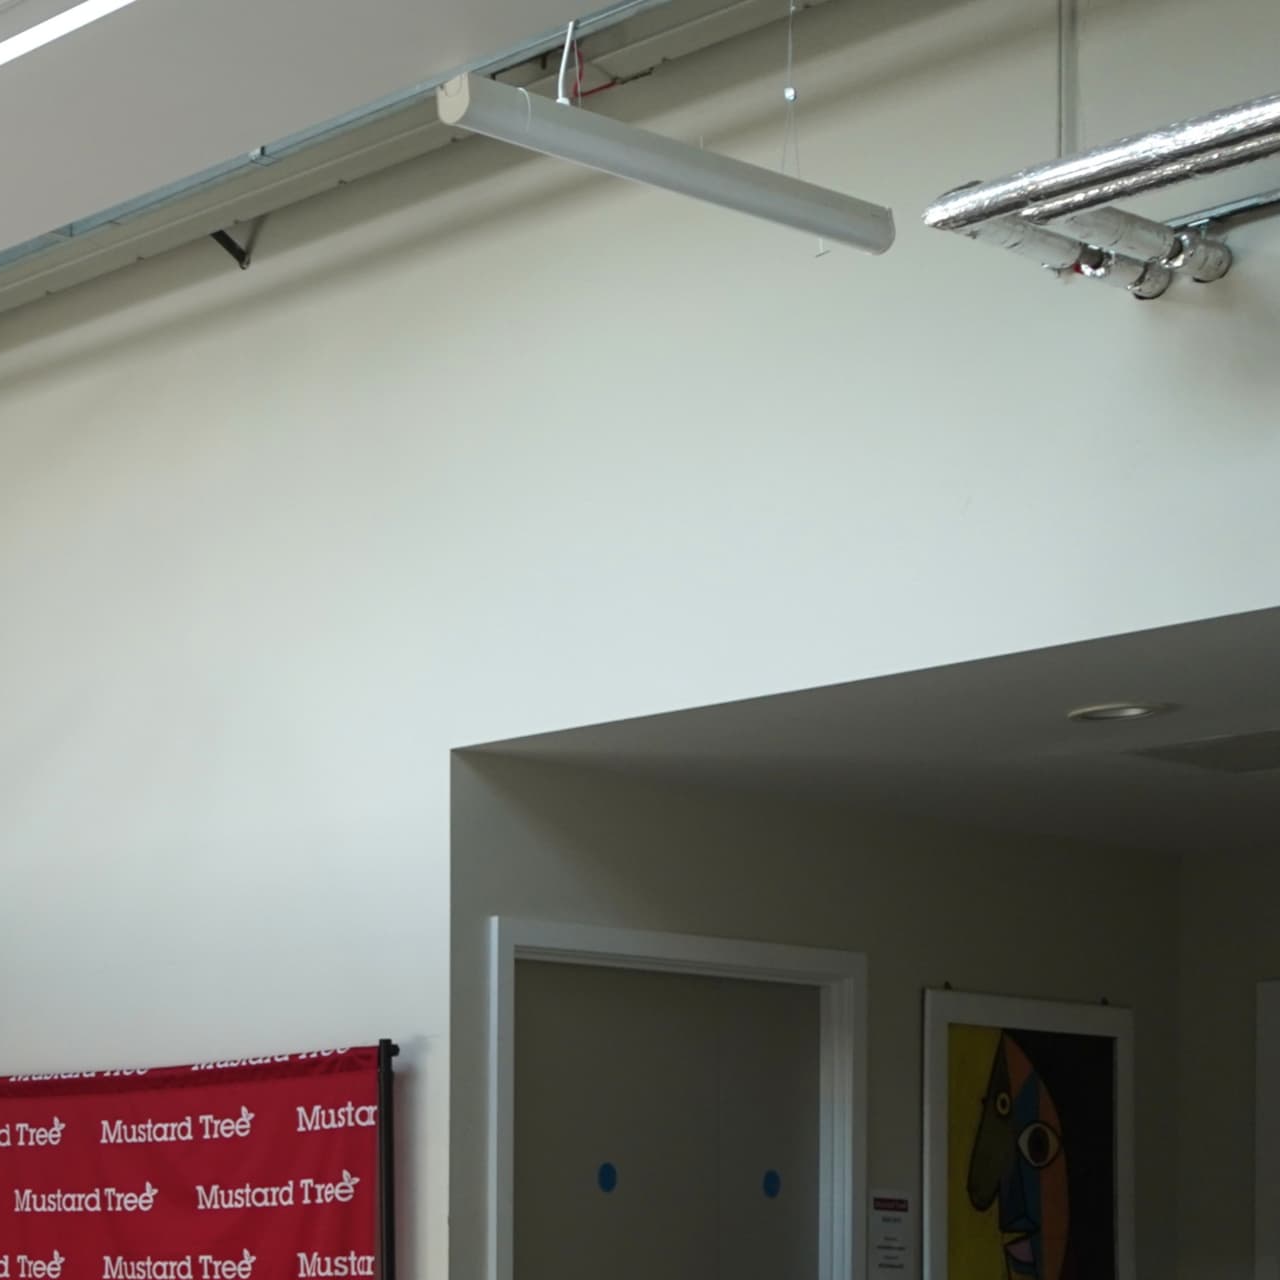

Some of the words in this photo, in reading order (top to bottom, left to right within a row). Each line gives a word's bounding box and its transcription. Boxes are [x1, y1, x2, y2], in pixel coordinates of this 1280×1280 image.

[100, 1116, 193, 1143] Mustard
[199, 1106, 254, 1139] Tree
[297, 1101, 378, 1131] Mustar
[16, 1117, 65, 1146] Tree
[14, 1188, 101, 1212] Mustard
[104, 1182, 158, 1211] Tree
[196, 1180, 294, 1209] Mustard
[300, 1170, 360, 1204] Tree
[17, 1250, 65, 1278] Tree
[103, 1256, 193, 1280] Mustard
[199, 1249, 256, 1279] Tree
[297, 1251, 375, 1277] Mustar
